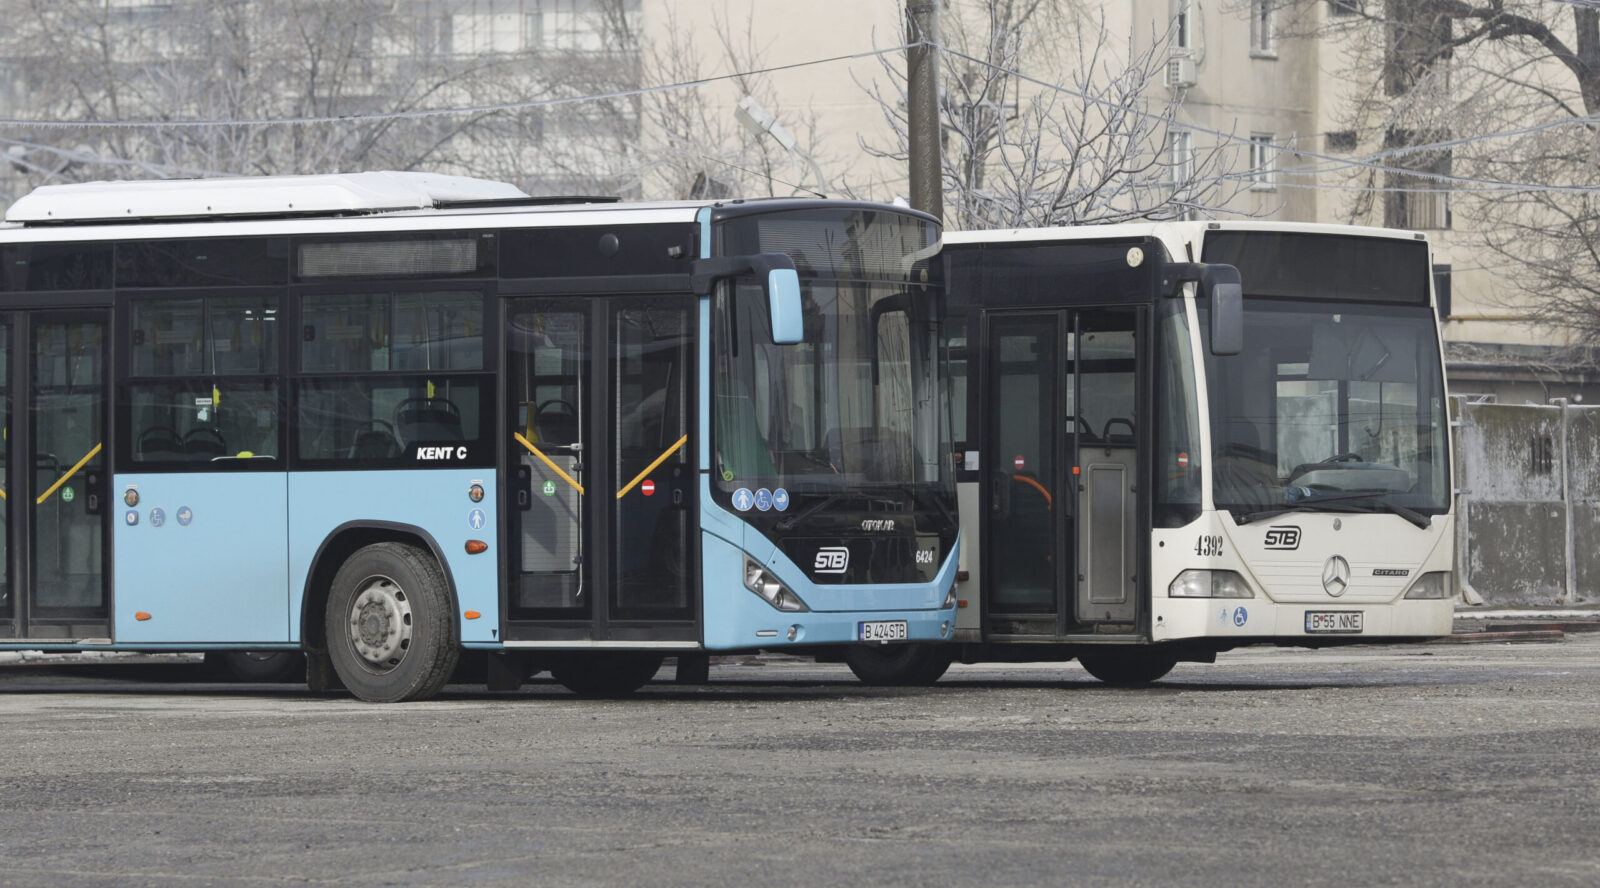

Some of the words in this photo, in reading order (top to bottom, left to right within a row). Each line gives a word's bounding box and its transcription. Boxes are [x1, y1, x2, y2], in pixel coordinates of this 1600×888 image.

[416, 446, 454, 460] KENT
[456, 446, 467, 460] C
[861, 519, 895, 531] OTOKAR
[1264, 529, 1298, 546] STB
[1194, 535, 1223, 557] 4392
[814, 551, 847, 569] STB
[915, 550, 933, 563] 6424
[1312, 614, 1320, 629] B
[1323, 614, 1335, 628] 55
[1339, 614, 1360, 629] NNE
[865, 624, 872, 639] B
